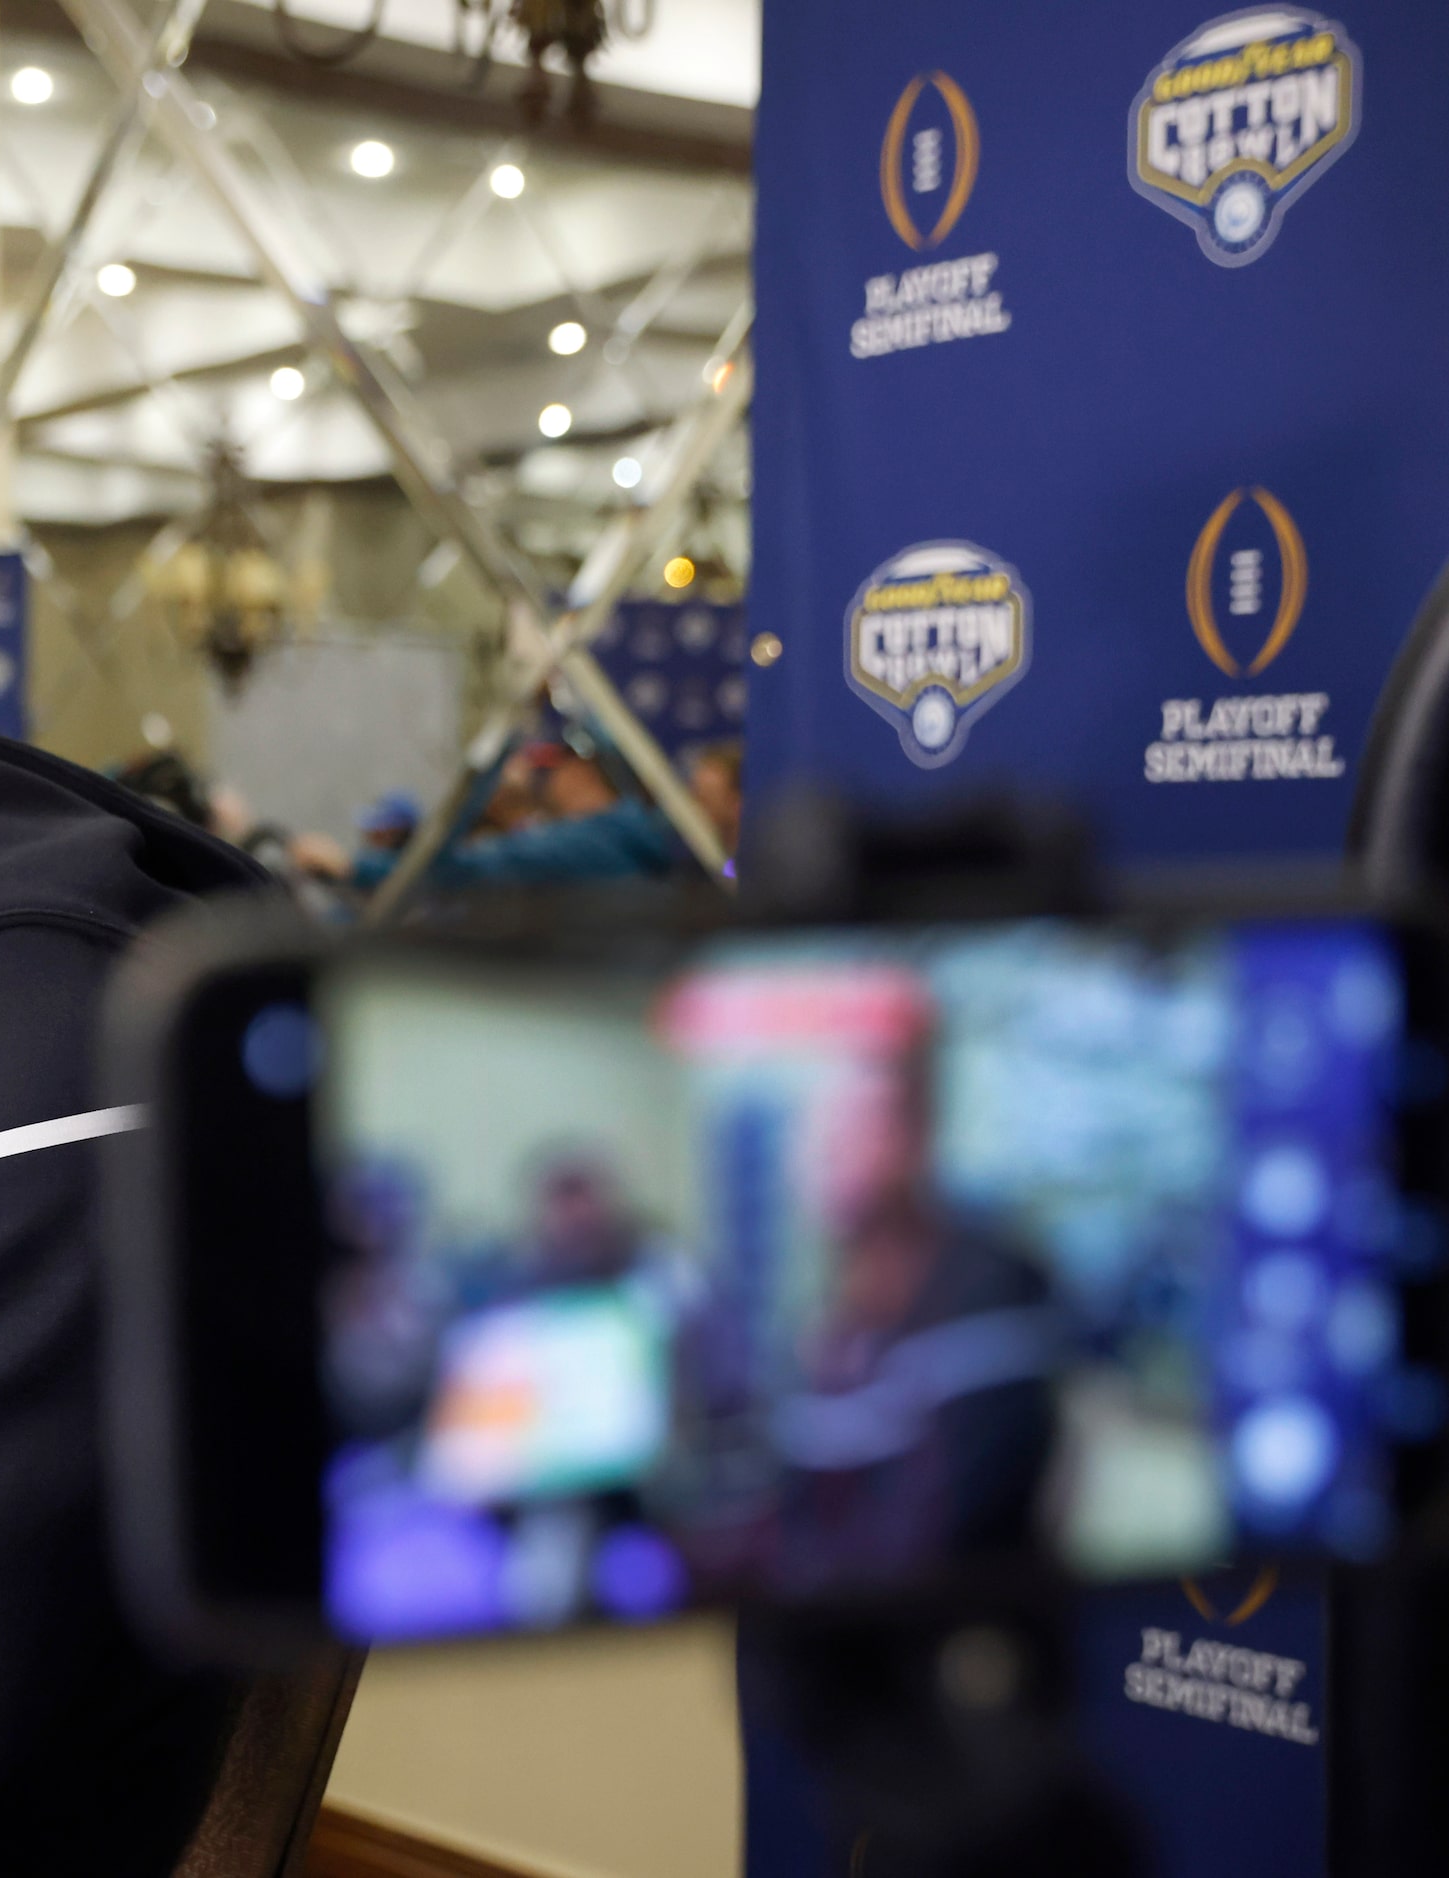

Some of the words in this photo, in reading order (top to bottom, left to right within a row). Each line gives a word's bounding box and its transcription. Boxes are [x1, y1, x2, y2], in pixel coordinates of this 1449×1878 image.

[1148, 65, 1339, 176] COTTON
[865, 252, 998, 317] PLAYOFF
[850, 291, 1012, 359] SEMIFINAL
[859, 603, 1012, 682] COTTON
[1160, 692, 1330, 740] PLAYOFF
[1144, 735, 1346, 783] SEMIFINAL
[1141, 1627, 1306, 1699] PLAYOFF
[1124, 1662, 1320, 1746] SEMIFINAL
